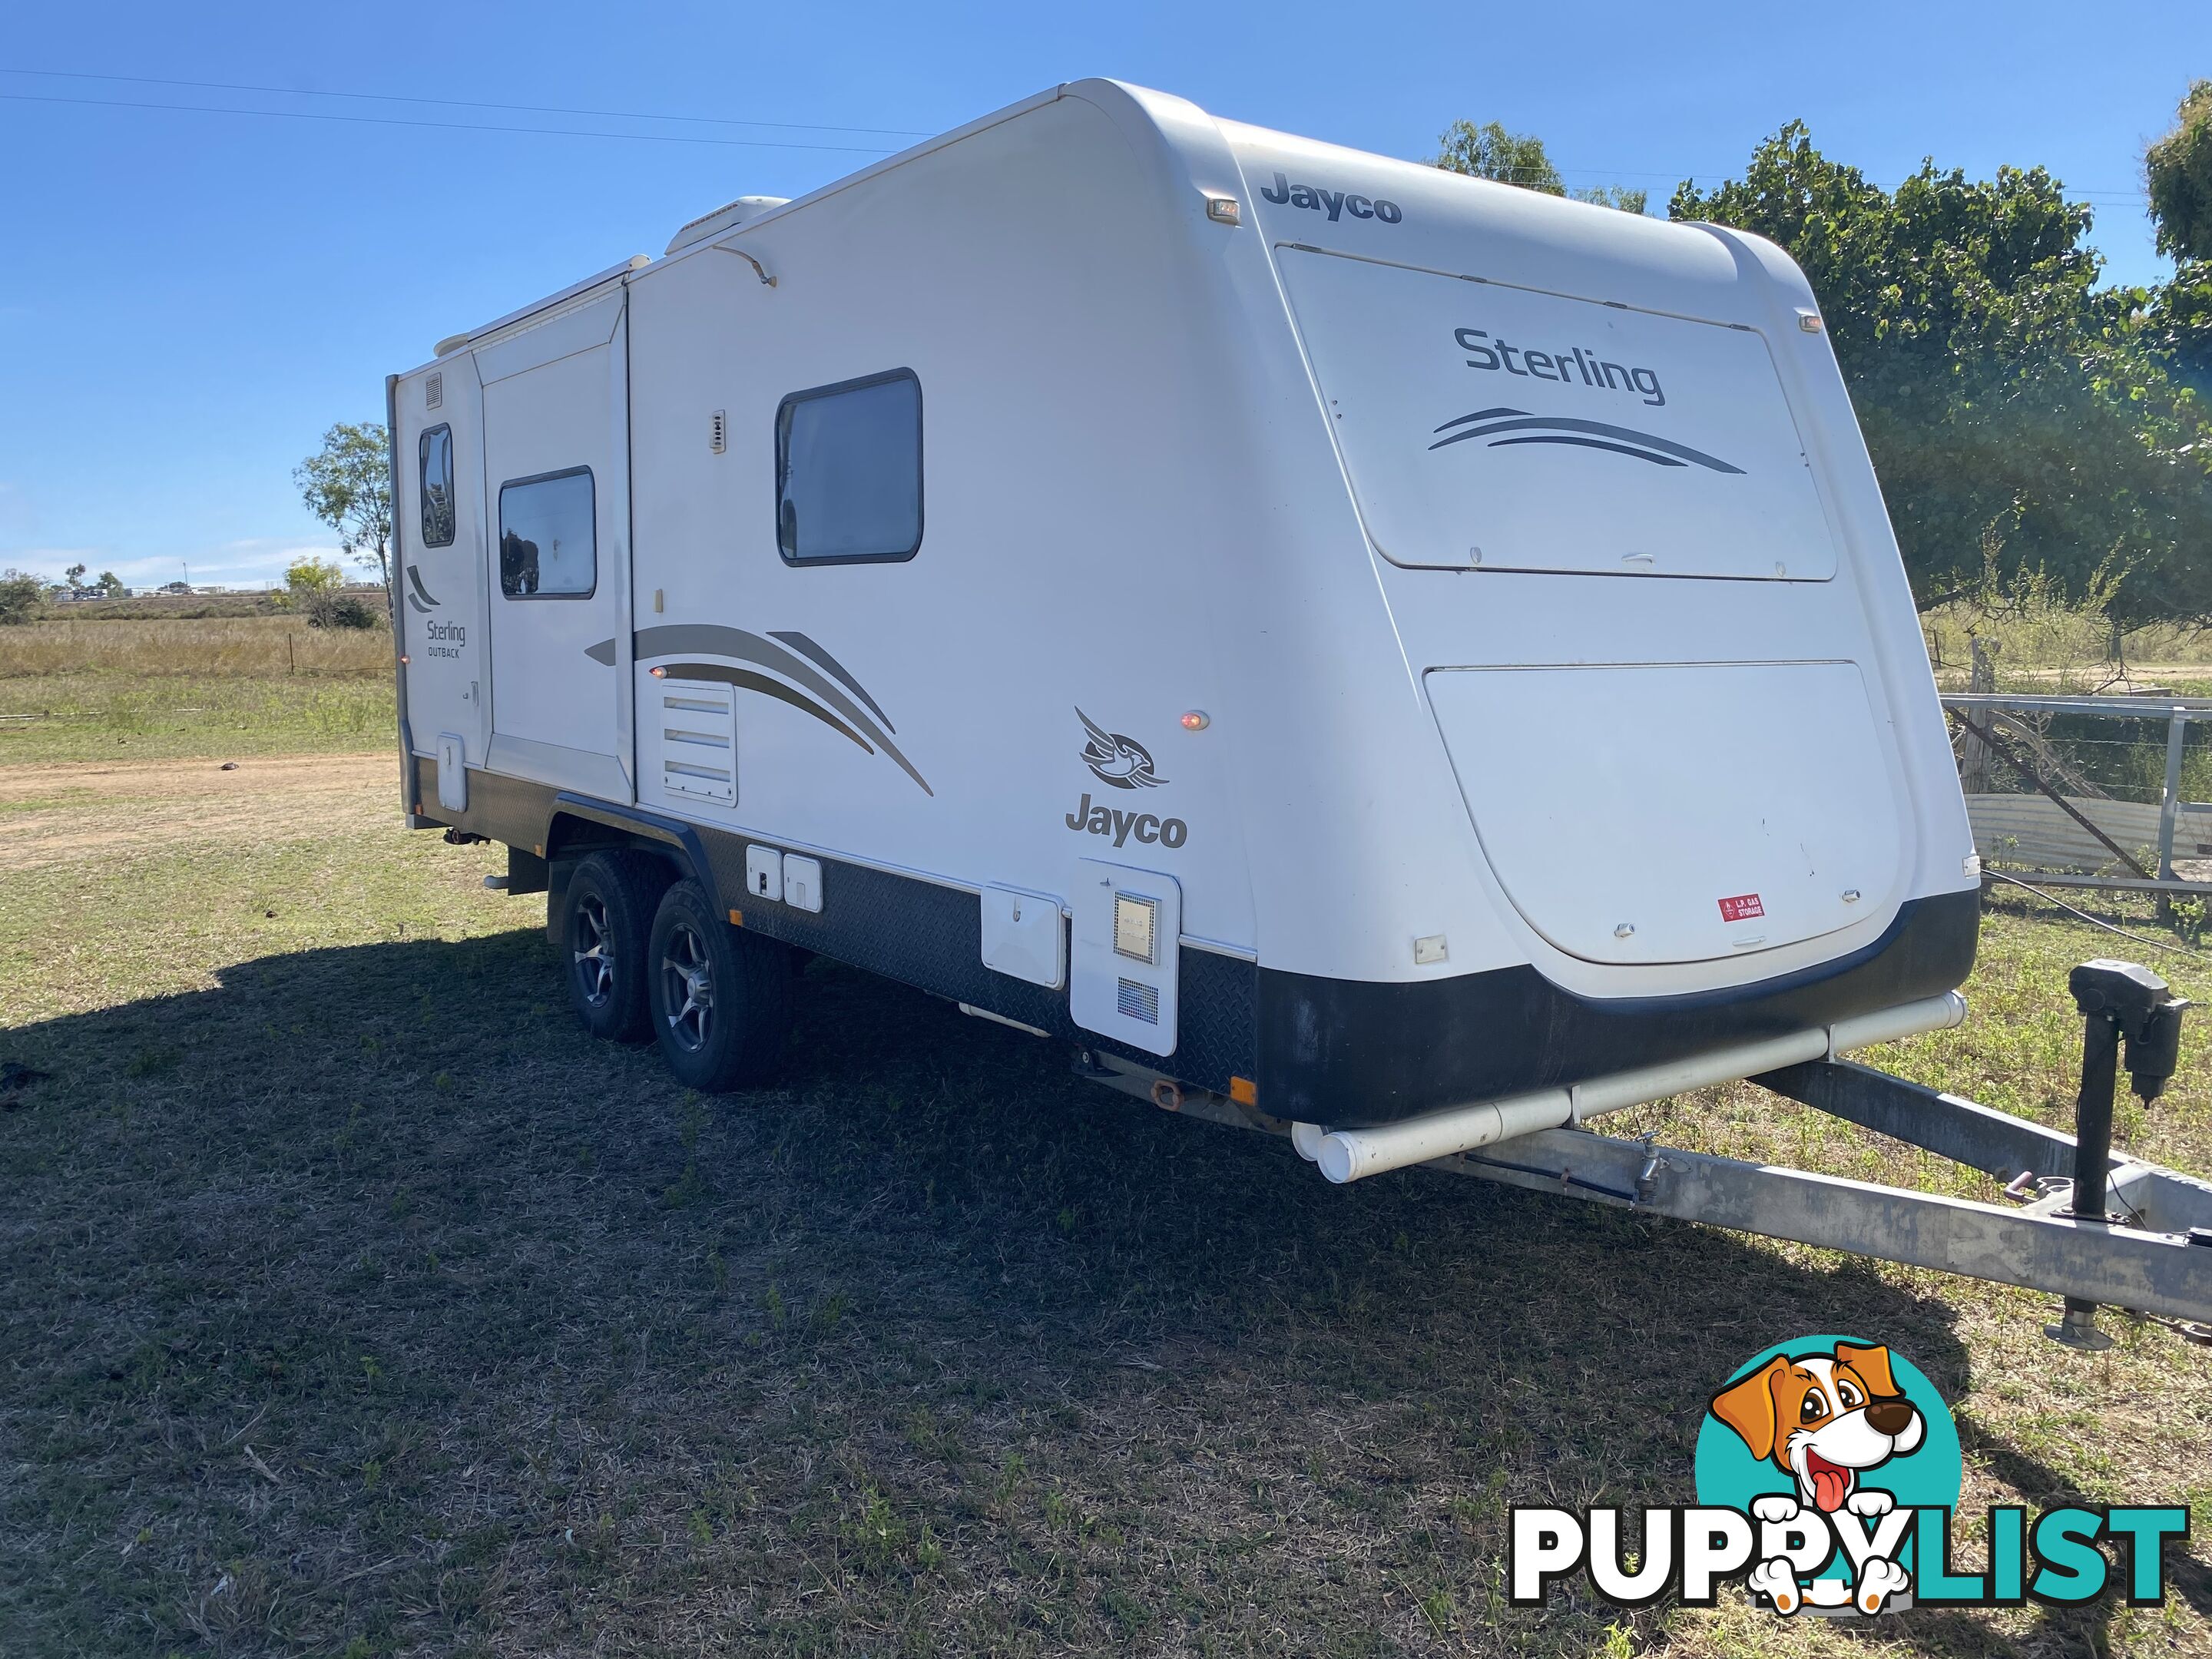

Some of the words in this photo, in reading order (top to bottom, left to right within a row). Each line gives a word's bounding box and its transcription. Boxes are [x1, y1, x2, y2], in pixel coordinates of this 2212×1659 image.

[1260, 171, 1402, 224] Jayco
[1454, 328, 1666, 406] Sterling
[427, 620, 465, 647] Sterling
[428, 647, 459, 659] OUTBACK
[1065, 793, 1187, 849] Jayco
[1738, 906, 1763, 917] STORAGE
[1747, 897, 1760, 906] GAS
